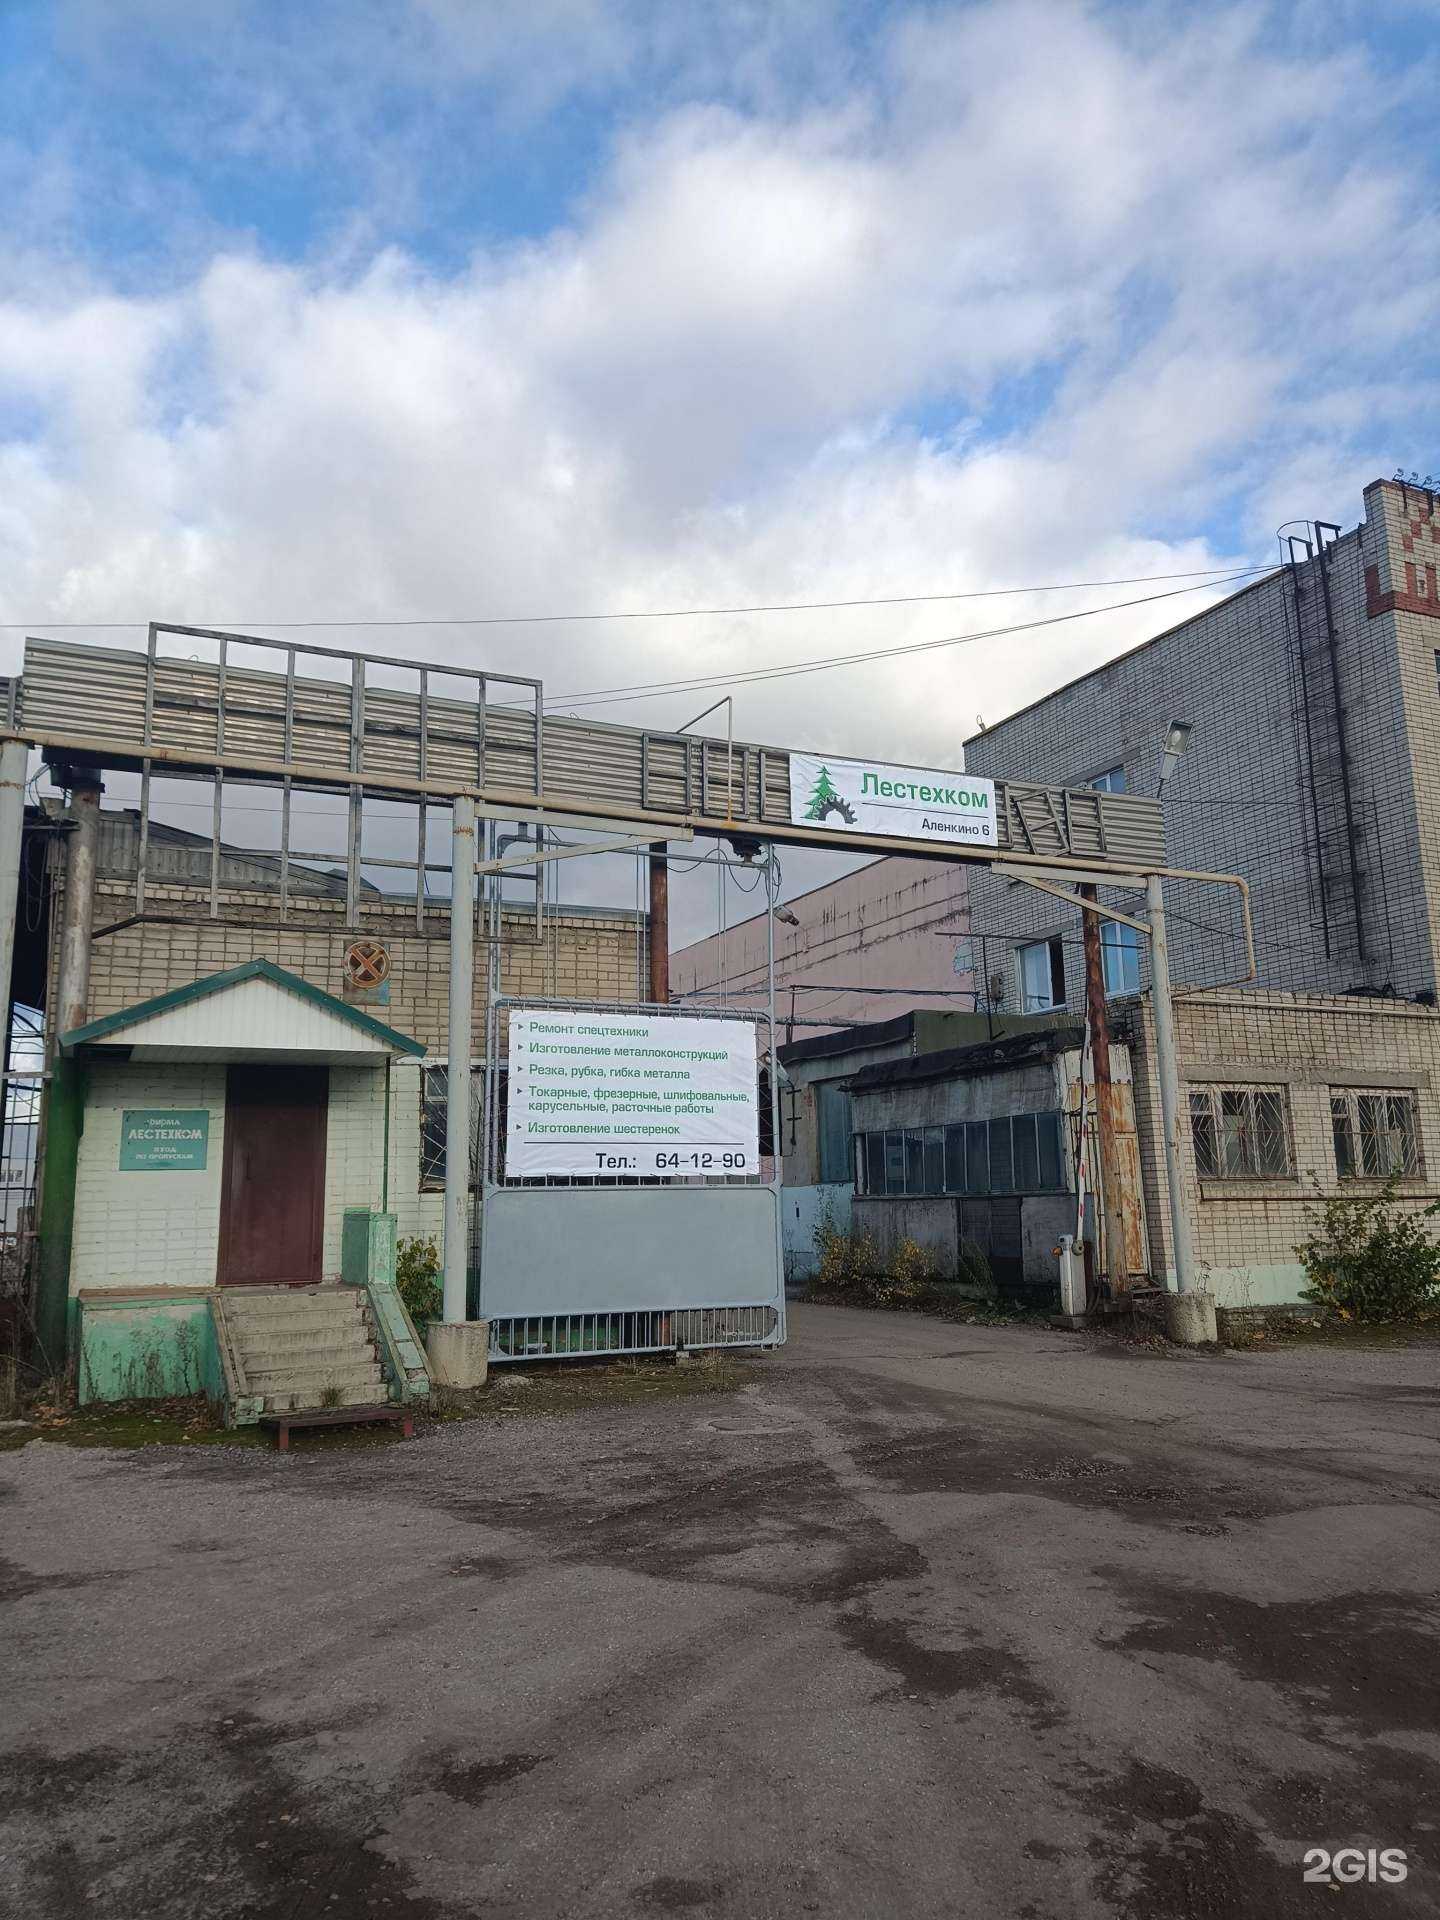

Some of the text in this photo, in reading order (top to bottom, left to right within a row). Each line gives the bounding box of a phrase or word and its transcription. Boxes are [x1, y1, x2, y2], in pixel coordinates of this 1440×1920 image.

[861, 773, 988, 808] Лестехком
[922, 818, 990, 836] Аленкино 6
[529, 1022, 649, 1037] Ремонт спецтехники
[529, 1043, 728, 1061] Изготовление металлоконструкций
[529, 1065, 690, 1079] Резка, рубка, гибка металла
[529, 1086, 750, 1103] Токарные, фрезерные, шлифовальные,
[529, 1102, 714, 1115] карусельные, расточные работы
[128, 1129, 202, 1139] ЛЕСТЕХКОМ
[528, 1122, 680, 1135] Изготовление шестеренок
[596, 1153, 745, 1168] Тел.: 64-12-90
